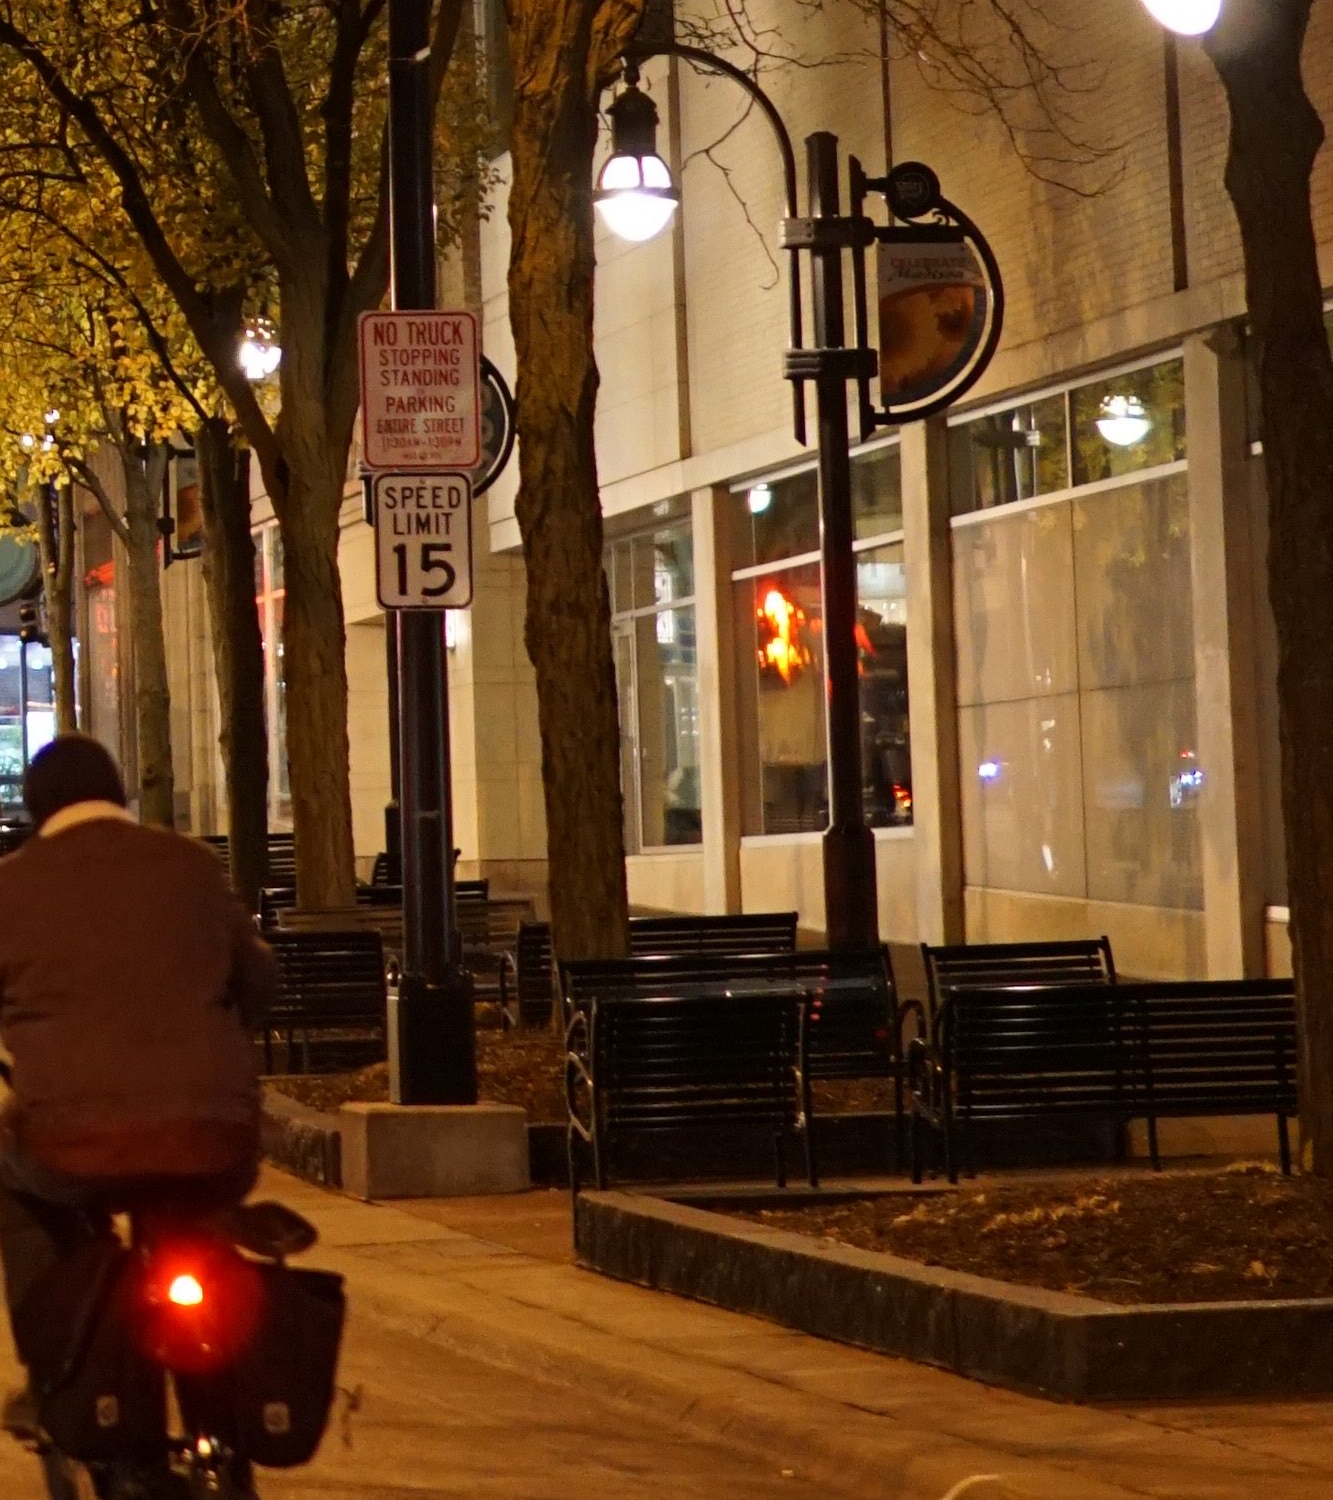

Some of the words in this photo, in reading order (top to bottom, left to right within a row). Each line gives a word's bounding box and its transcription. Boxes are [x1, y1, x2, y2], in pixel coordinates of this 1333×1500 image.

[373, 321, 397, 346] NO
[407, 320, 464, 345] TRUCK
[379, 348, 460, 366] STOPPING
[380, 368, 460, 386] STANDING
[385, 396, 456, 414] PARKING
[377, 418, 417, 434] ENTIRE
[423, 417, 465, 434] STREET
[384, 486, 461, 510] SPEED
[393, 512, 453, 536] LIMIT
[393, 542, 456, 597] 15
